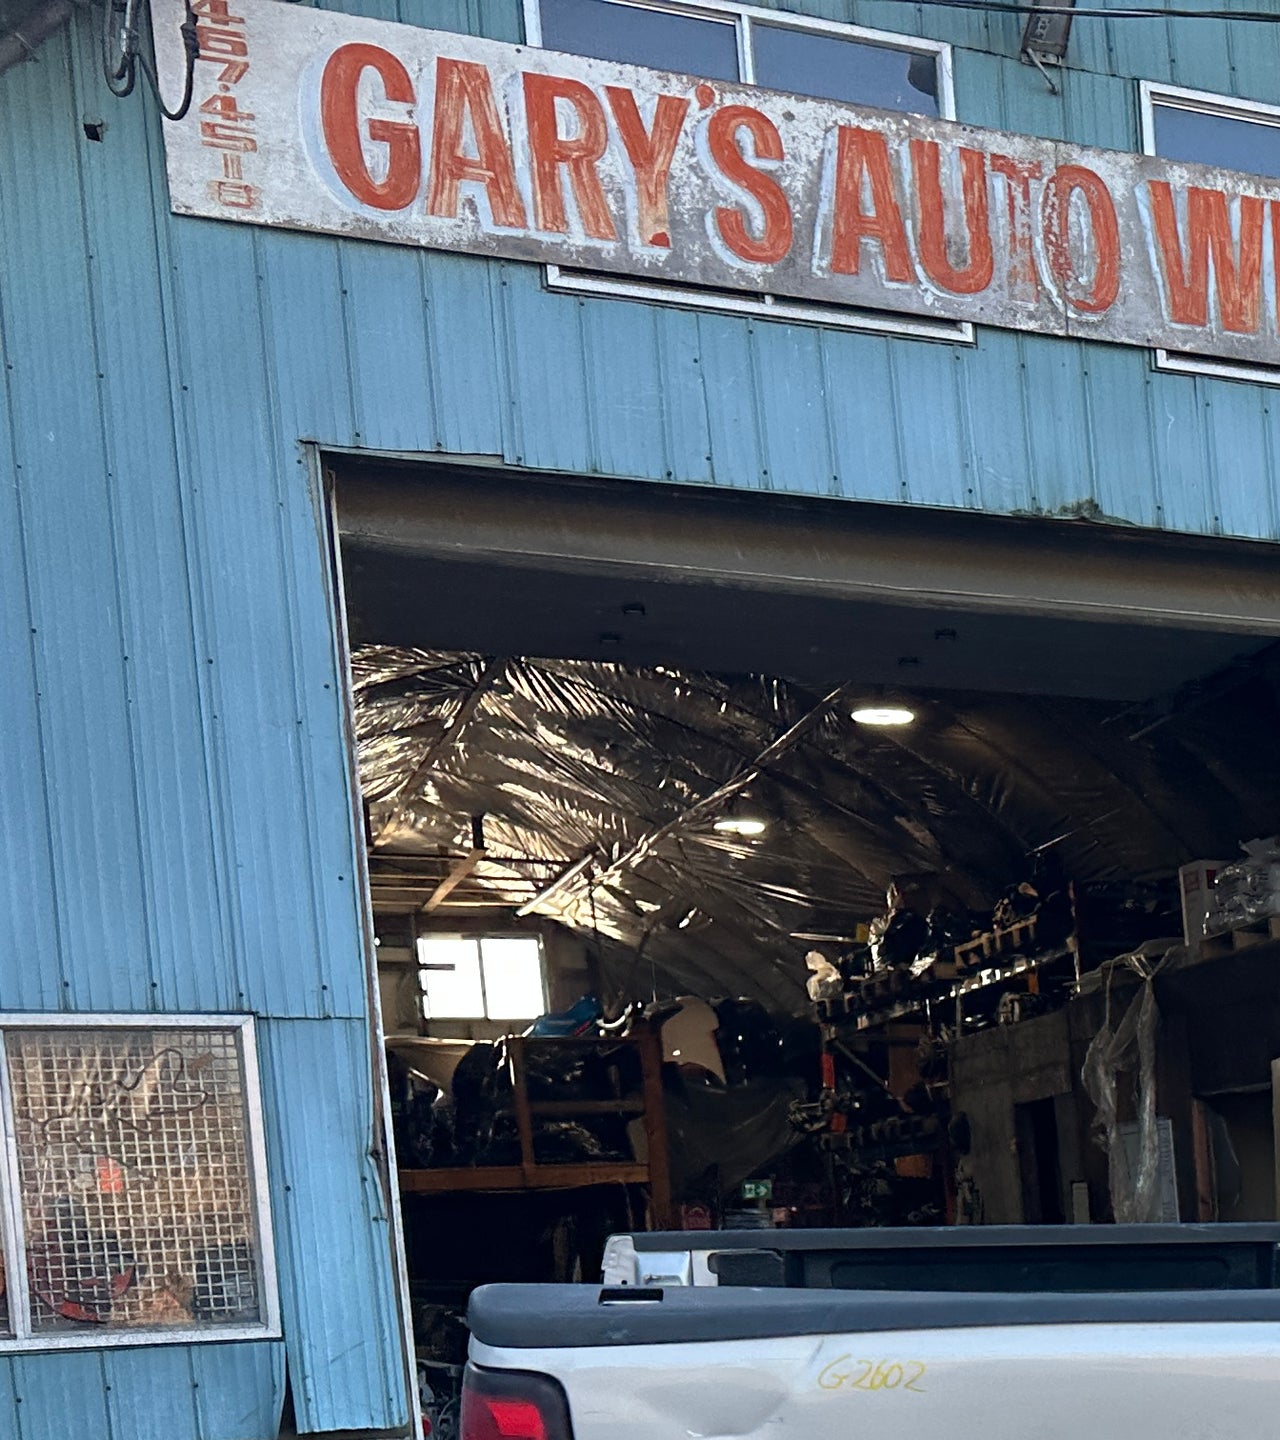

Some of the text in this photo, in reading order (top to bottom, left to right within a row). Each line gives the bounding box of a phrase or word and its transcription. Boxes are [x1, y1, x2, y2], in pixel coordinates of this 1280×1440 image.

[320, 42, 794, 265] GARY'S
[830, 125, 1121, 315] AUTO
[817, 1354, 928, 1393] G2602
